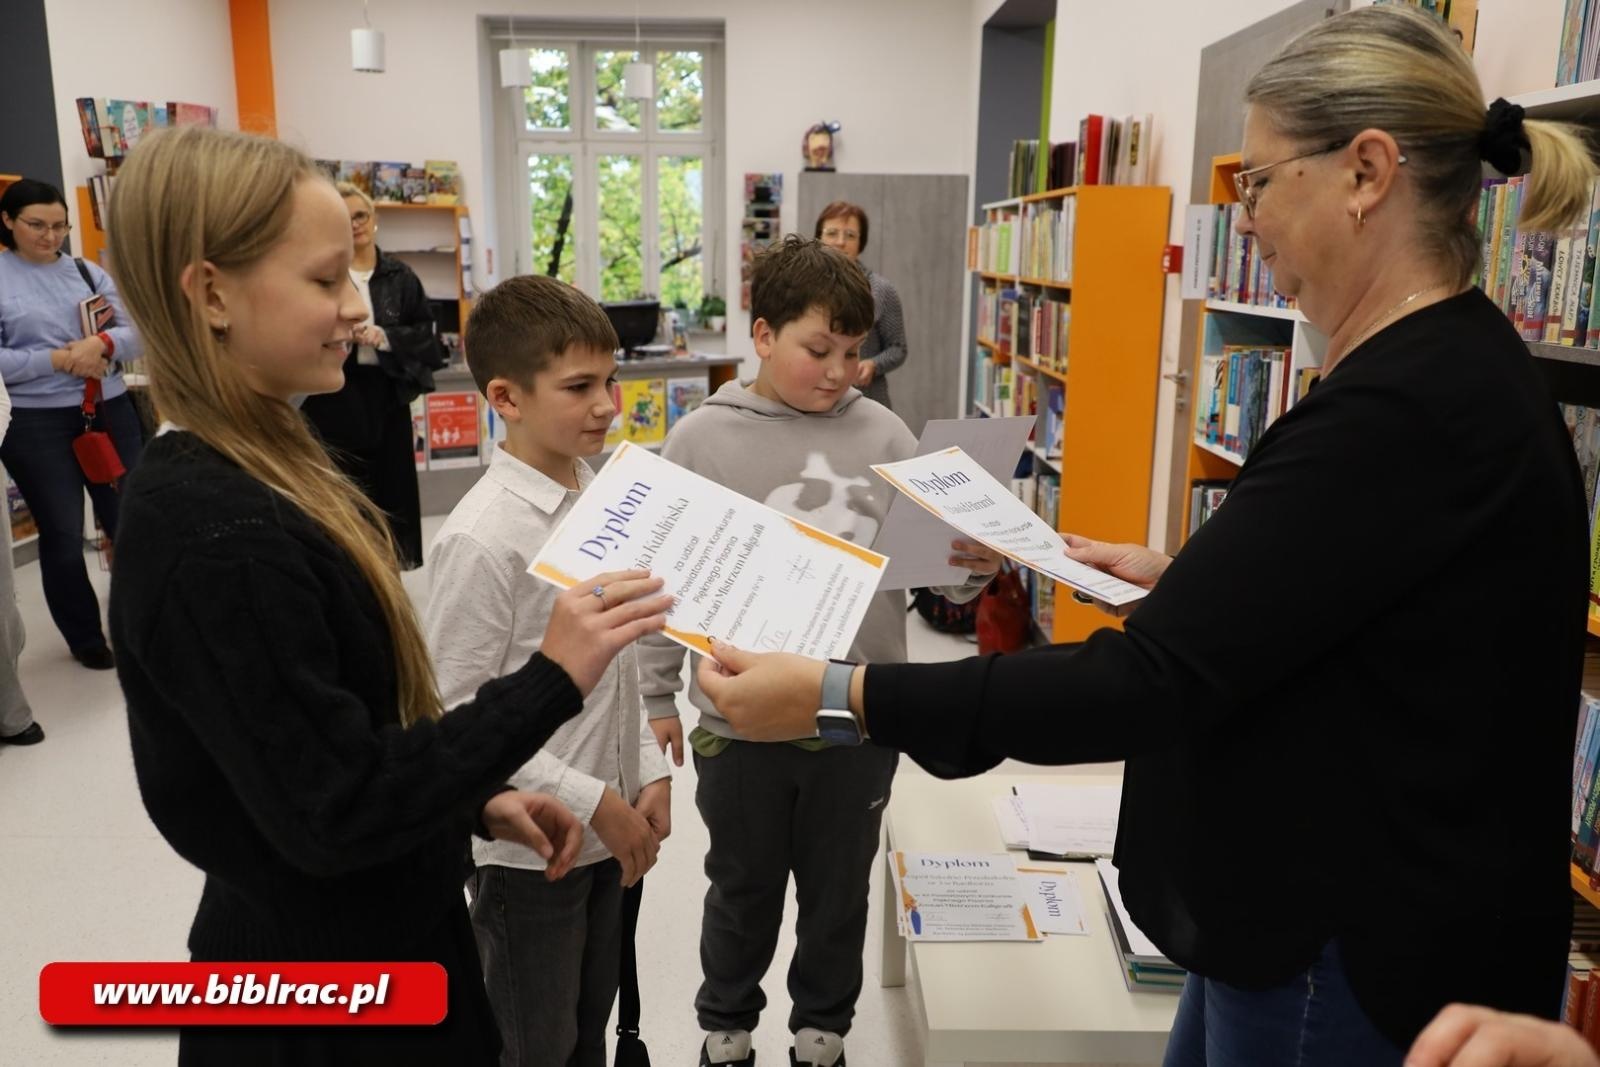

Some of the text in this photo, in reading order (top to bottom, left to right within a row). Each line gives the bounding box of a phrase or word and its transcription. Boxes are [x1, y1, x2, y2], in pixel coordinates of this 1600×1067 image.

[908, 471, 971, 496] Dyplom
[579, 482, 651, 560] Dyplom
[643, 498, 689, 554] Kuklińska
[674, 536, 698, 572] za udział
[676, 546, 713, 597] Powiatowym
[708, 508, 736, 545] Konkursie
[692, 536, 738, 604] Pięknego Pisania
[698, 600, 722, 632] Zostań
[715, 560, 744, 597] Mistrzem
[920, 859, 990, 869] Dyplom
[1039, 880, 1062, 918] Dyplom
